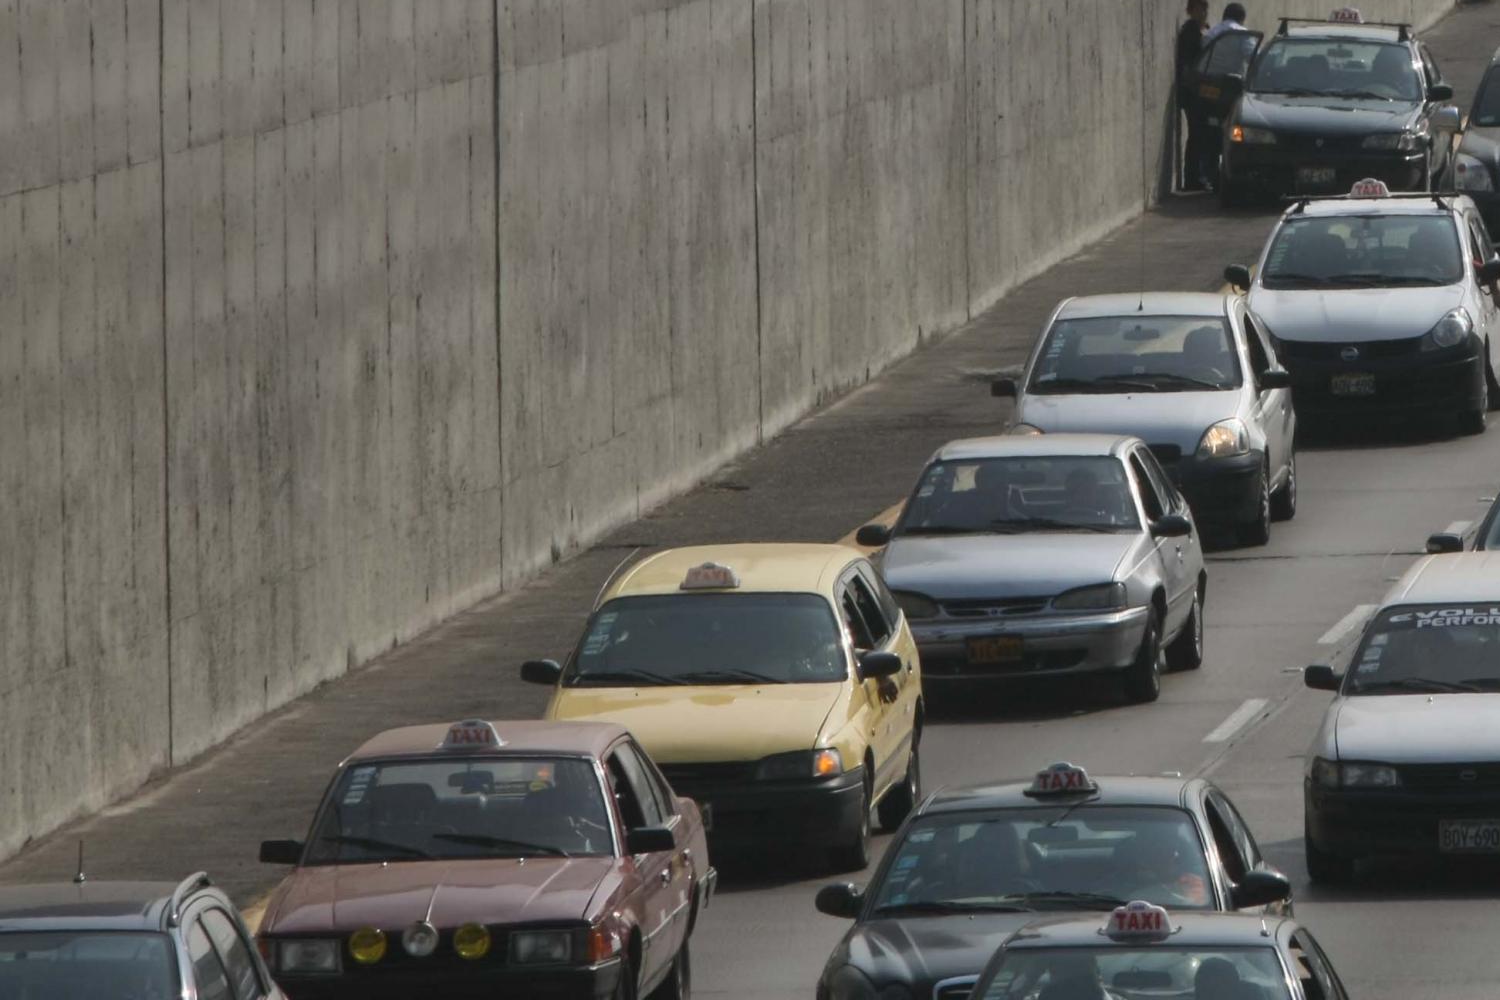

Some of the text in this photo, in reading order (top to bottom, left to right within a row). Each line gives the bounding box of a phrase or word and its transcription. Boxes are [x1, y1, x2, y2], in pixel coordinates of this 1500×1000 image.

[1333, 11, 1358, 20] TAXI
[1356, 184, 1382, 195] TAXI
[691, 570, 728, 581] TAXI
[450, 728, 490, 744] TAXI
[1038, 773, 1083, 788] TAXI
[1115, 912, 1161, 931] TAXI
